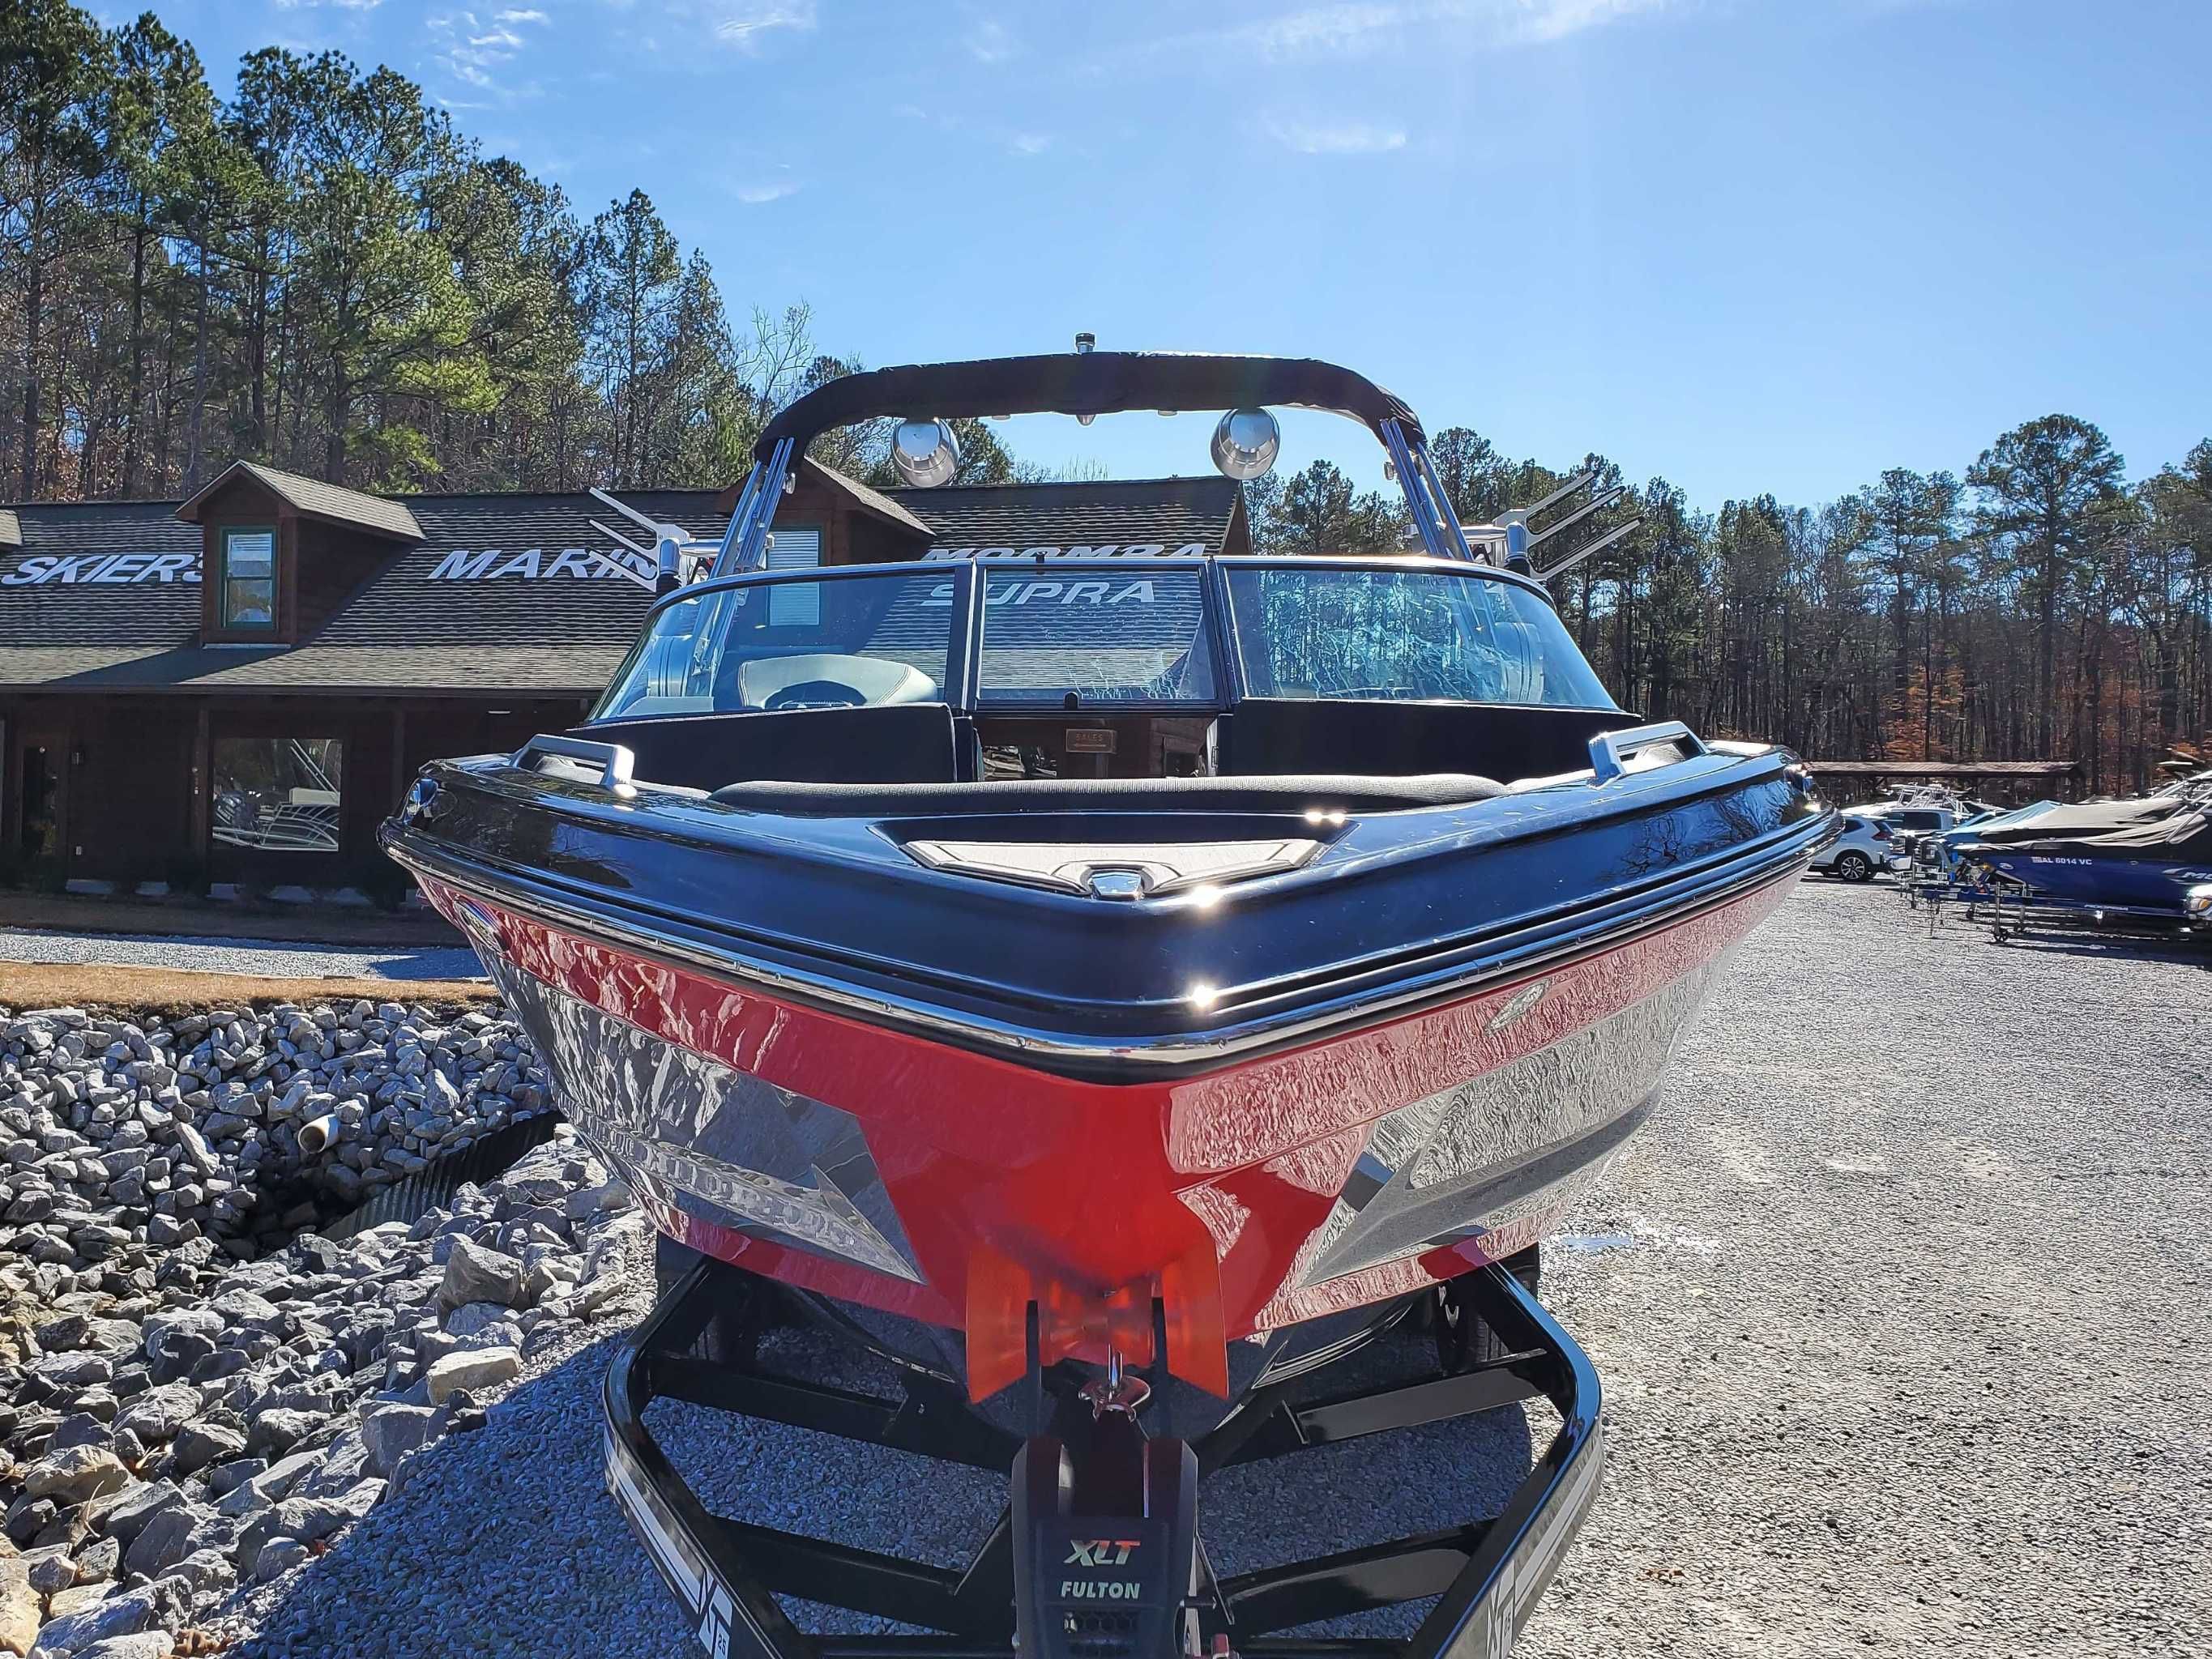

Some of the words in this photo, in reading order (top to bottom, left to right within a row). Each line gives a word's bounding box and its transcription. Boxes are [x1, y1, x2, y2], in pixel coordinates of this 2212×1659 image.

[427, 548, 658, 579] MARIN
[920, 580, 1155, 607] SUPRA
[1063, 1539, 1141, 1567] XLT
[1061, 1580, 1141, 1600] FULTON
